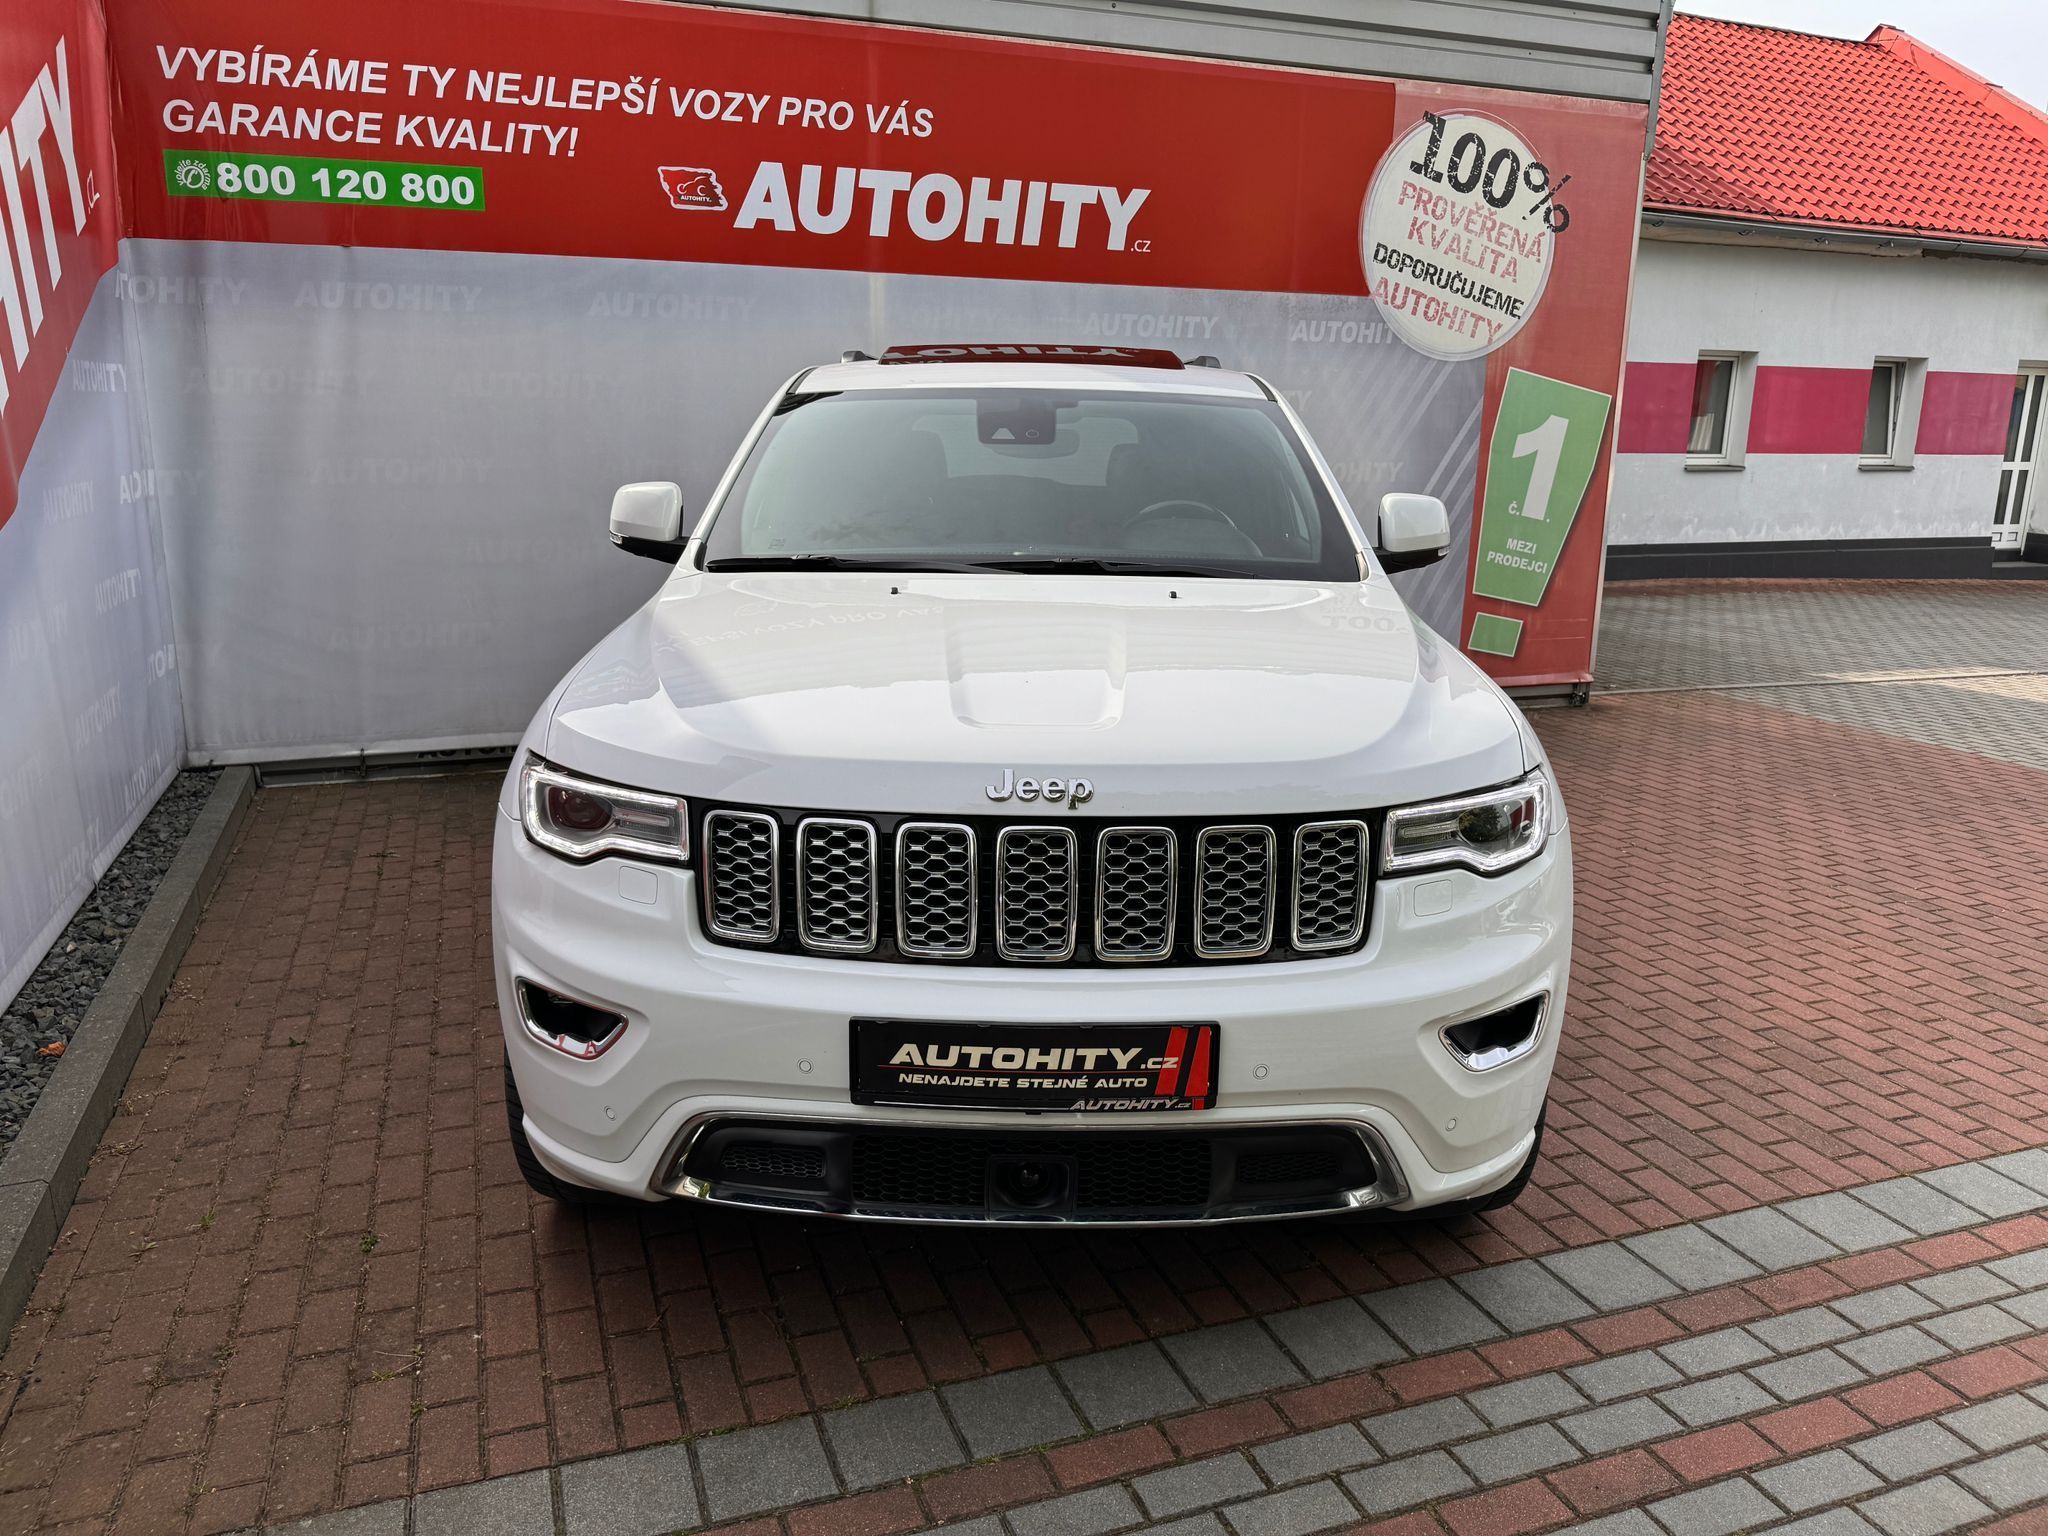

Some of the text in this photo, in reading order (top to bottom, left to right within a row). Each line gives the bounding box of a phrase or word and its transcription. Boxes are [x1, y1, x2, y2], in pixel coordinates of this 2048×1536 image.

[156, 45, 934, 138] VYBÍRÁME TY NEJLEPŠÍ VOZY PRO VÁS
[162, 99, 579, 157] GARANCE KVALITY!
[193, 159, 211, 190] zdarma
[216, 162, 475, 205] 800 120 800
[1409, 110, 1571, 233] 100%
[1397, 180, 1546, 263] PROVĚŘENÁ
[1407, 216, 1518, 283] KVALITA
[1372, 242, 1524, 320] DOPORUČUJEME
[1083, 311, 1219, 340] AUTOHITY
[1291, 319, 1406, 345] AUTOHIT
[1373, 276, 1503, 346] AUTOHITY
[1486, 551, 1549, 575] PRODEJCI
[1506, 538, 1538, 555] MEZI
[985, 768, 1094, 810] Jeep
[898, 1073, 1148, 1089] NENAJDETE STEJNÉ AUTO
